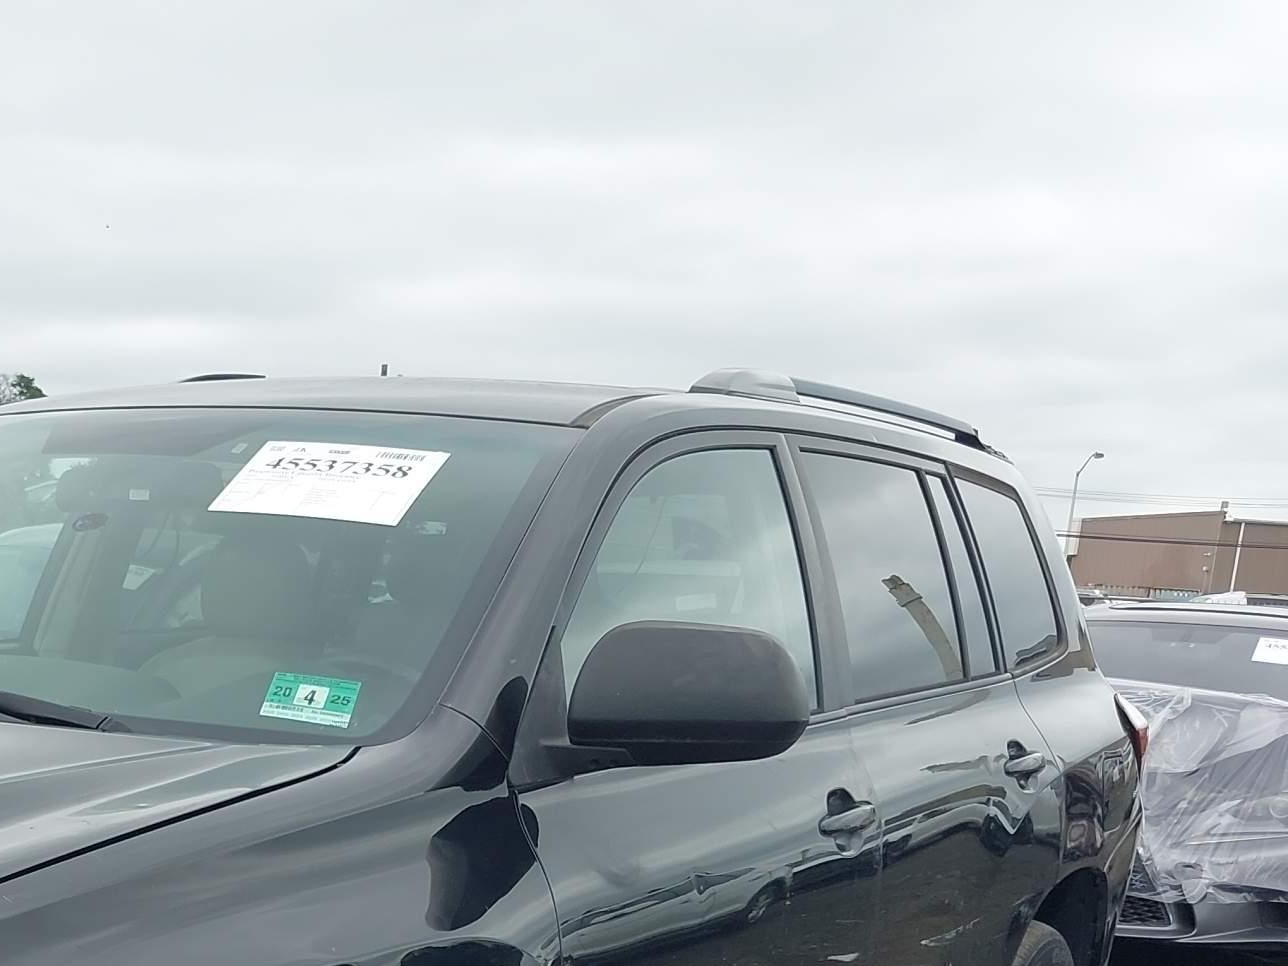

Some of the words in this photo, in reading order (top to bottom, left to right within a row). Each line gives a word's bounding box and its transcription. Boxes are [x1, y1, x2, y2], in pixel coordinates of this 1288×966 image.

[265, 456, 413, 479] 45537358
[272, 685, 293, 698] 20
[303, 689, 318, 706] 4
[330, 694, 352, 706] 25
